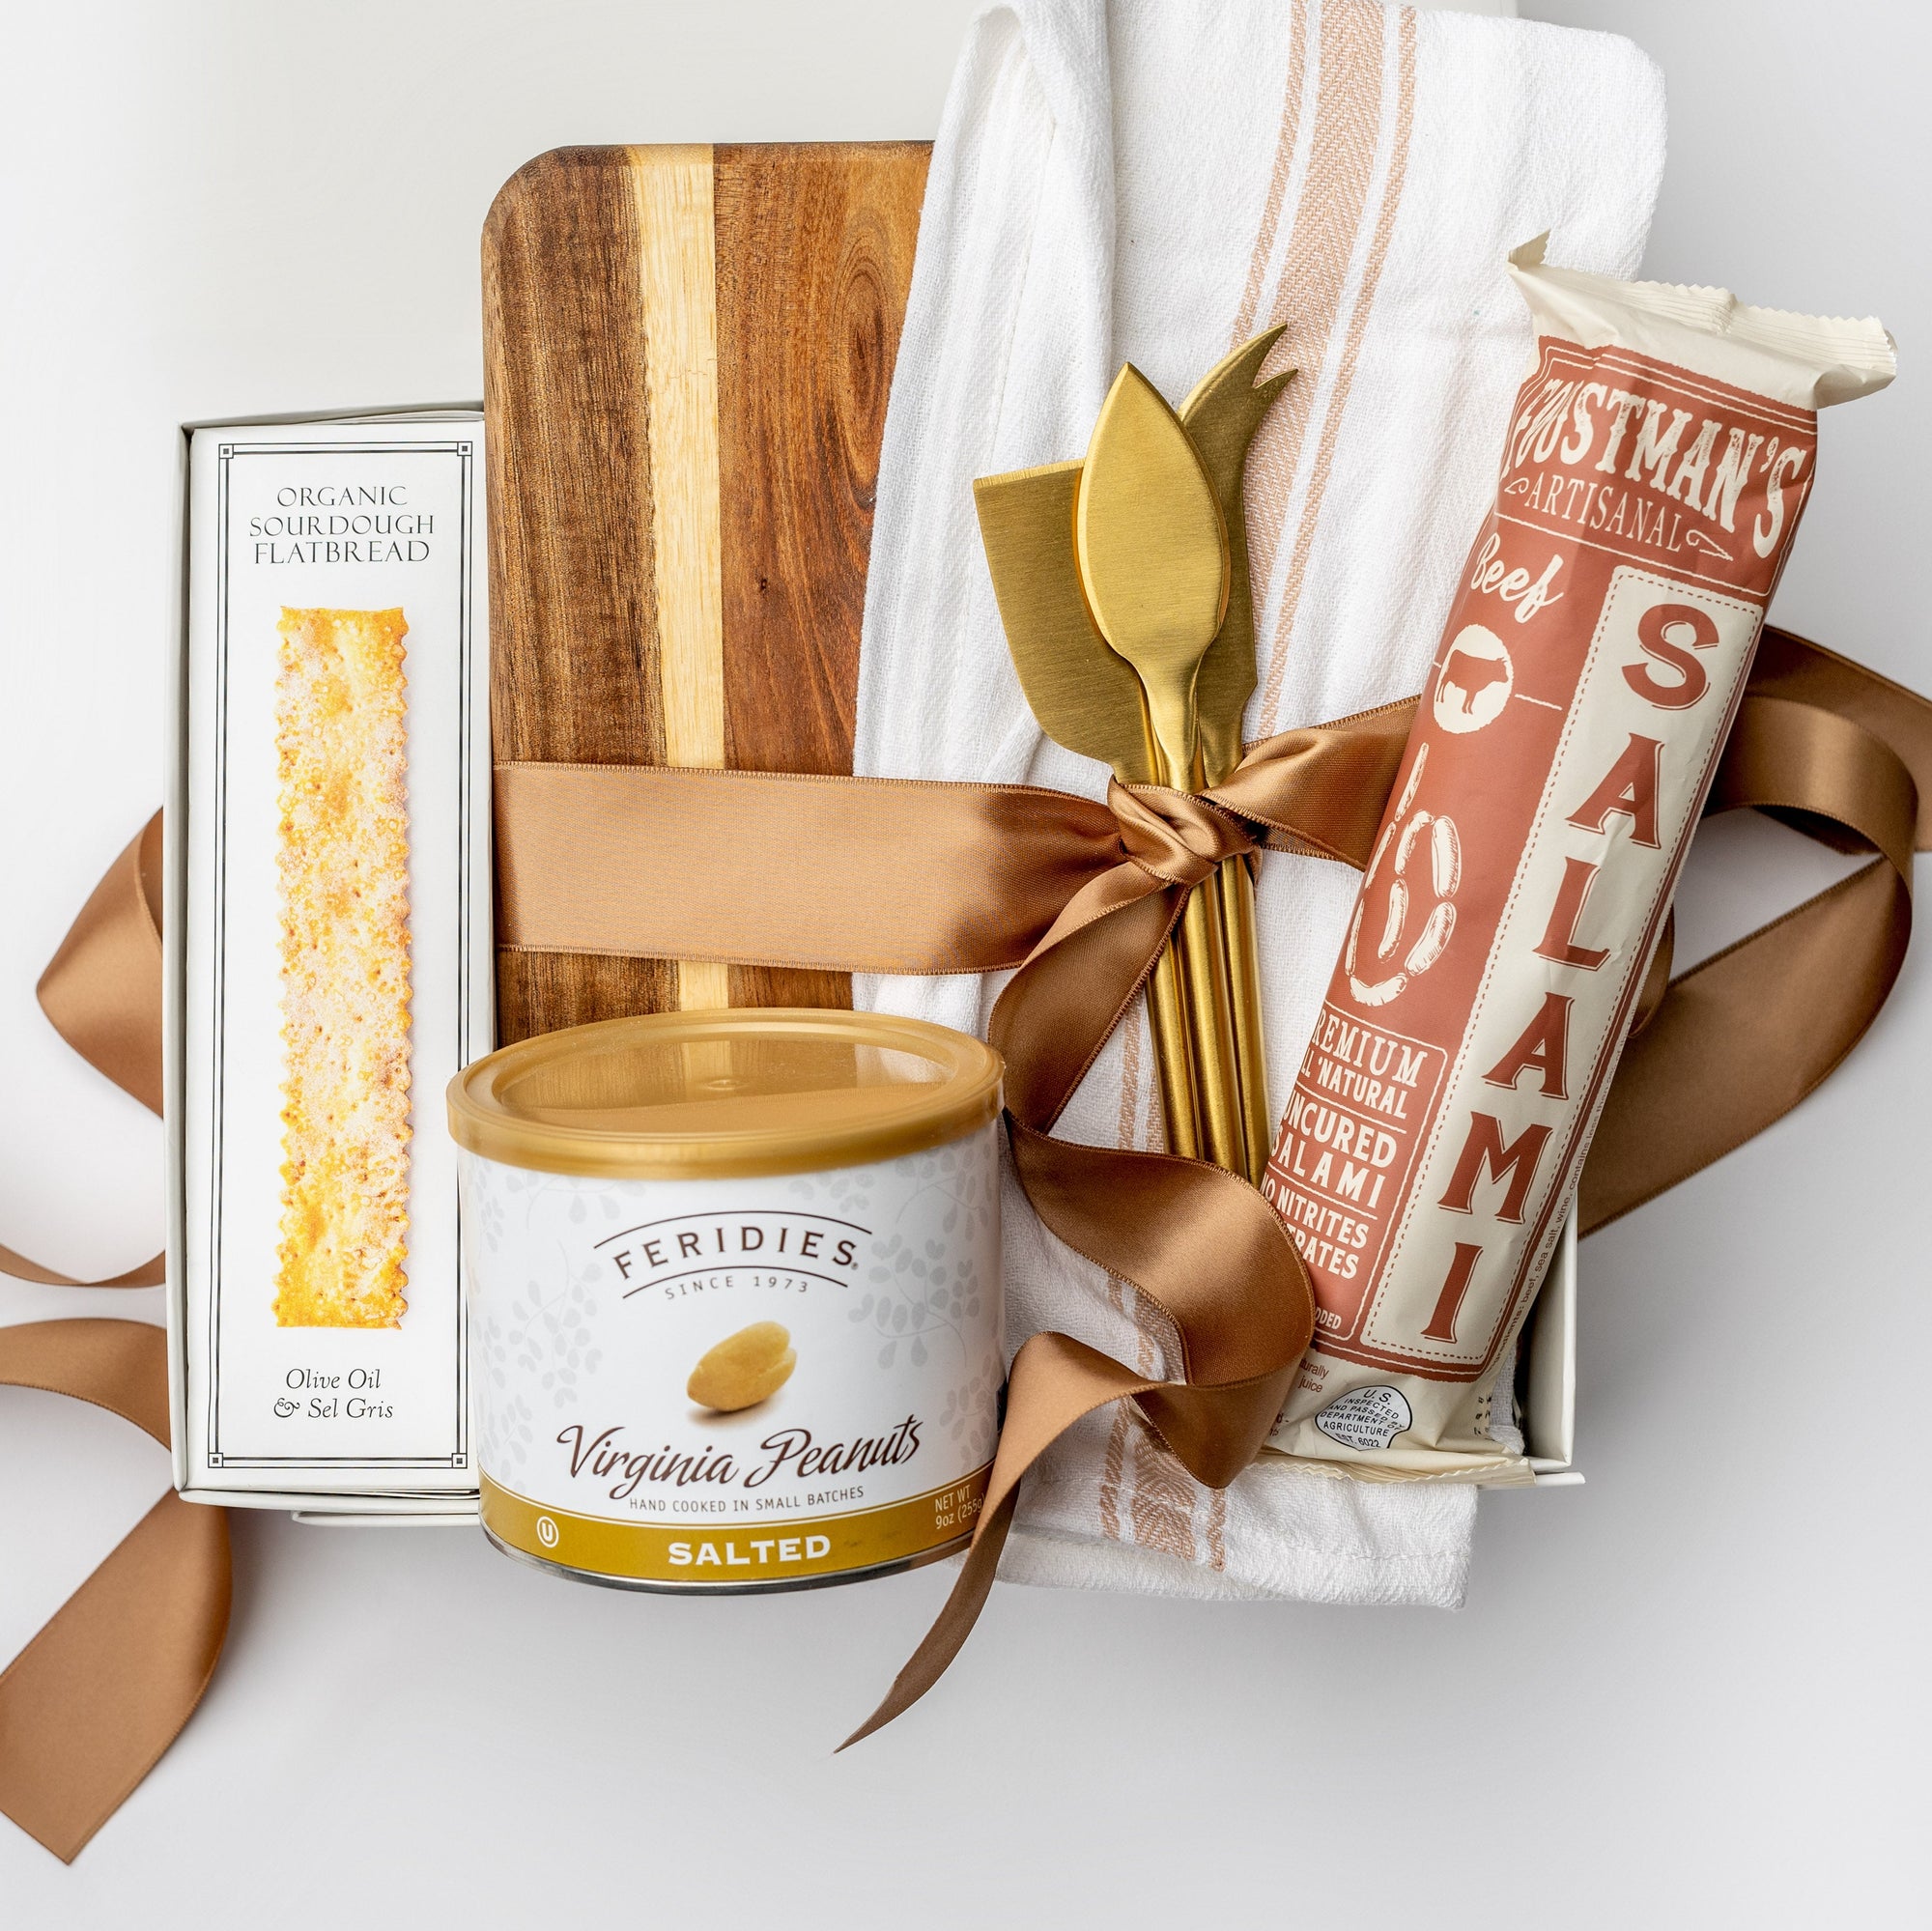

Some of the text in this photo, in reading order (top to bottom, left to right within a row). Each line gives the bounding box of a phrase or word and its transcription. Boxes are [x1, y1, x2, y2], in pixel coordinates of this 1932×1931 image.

[276, 485, 409, 507] ORGANIC
[1522, 471, 1683, 552] ARTISANAL
[249, 514, 435, 537] SOURDOUGH
[254, 540, 430, 564] FLATBREAD
[1470, 533, 1565, 624] Beef
[1420, 603, 1720, 1344] SALAMI
[1271, 1125, 1386, 1208] SALAMI
[1276, 1184, 1370, 1249] NITRITES
[1534, 1252, 1549, 1273] sea
[1545, 1226, 1561, 1249] salt,
[1555, 1194, 1574, 1224] wine,
[1569, 1141, 1590, 1191] contains
[665, 1275, 808, 1300] SINCE 1973
[286, 1368, 382, 1389] Olive Oil
[1299, 1358, 1329, 1379] turally
[1298, 1376, 1323, 1393] juice
[273, 1397, 393, 1418] & Sel Gris
[1320, 1411, 1383, 1426] DEPARTMENT
[1344, 1398, 1400, 1420] INSPECTED
[1350, 1406, 1388, 1421] PASSED
[1323, 1421, 1390, 1437] AGRICULTURE
[555, 1413, 924, 1500] Virginia Peanuts
[630, 1485, 865, 1513] HAND COOKED IN SMALL BATCHES
[935, 1484, 971, 1513] NET WT
[935, 1513, 954, 1530] 9oz
[668, 1534, 832, 1566] SALTED
